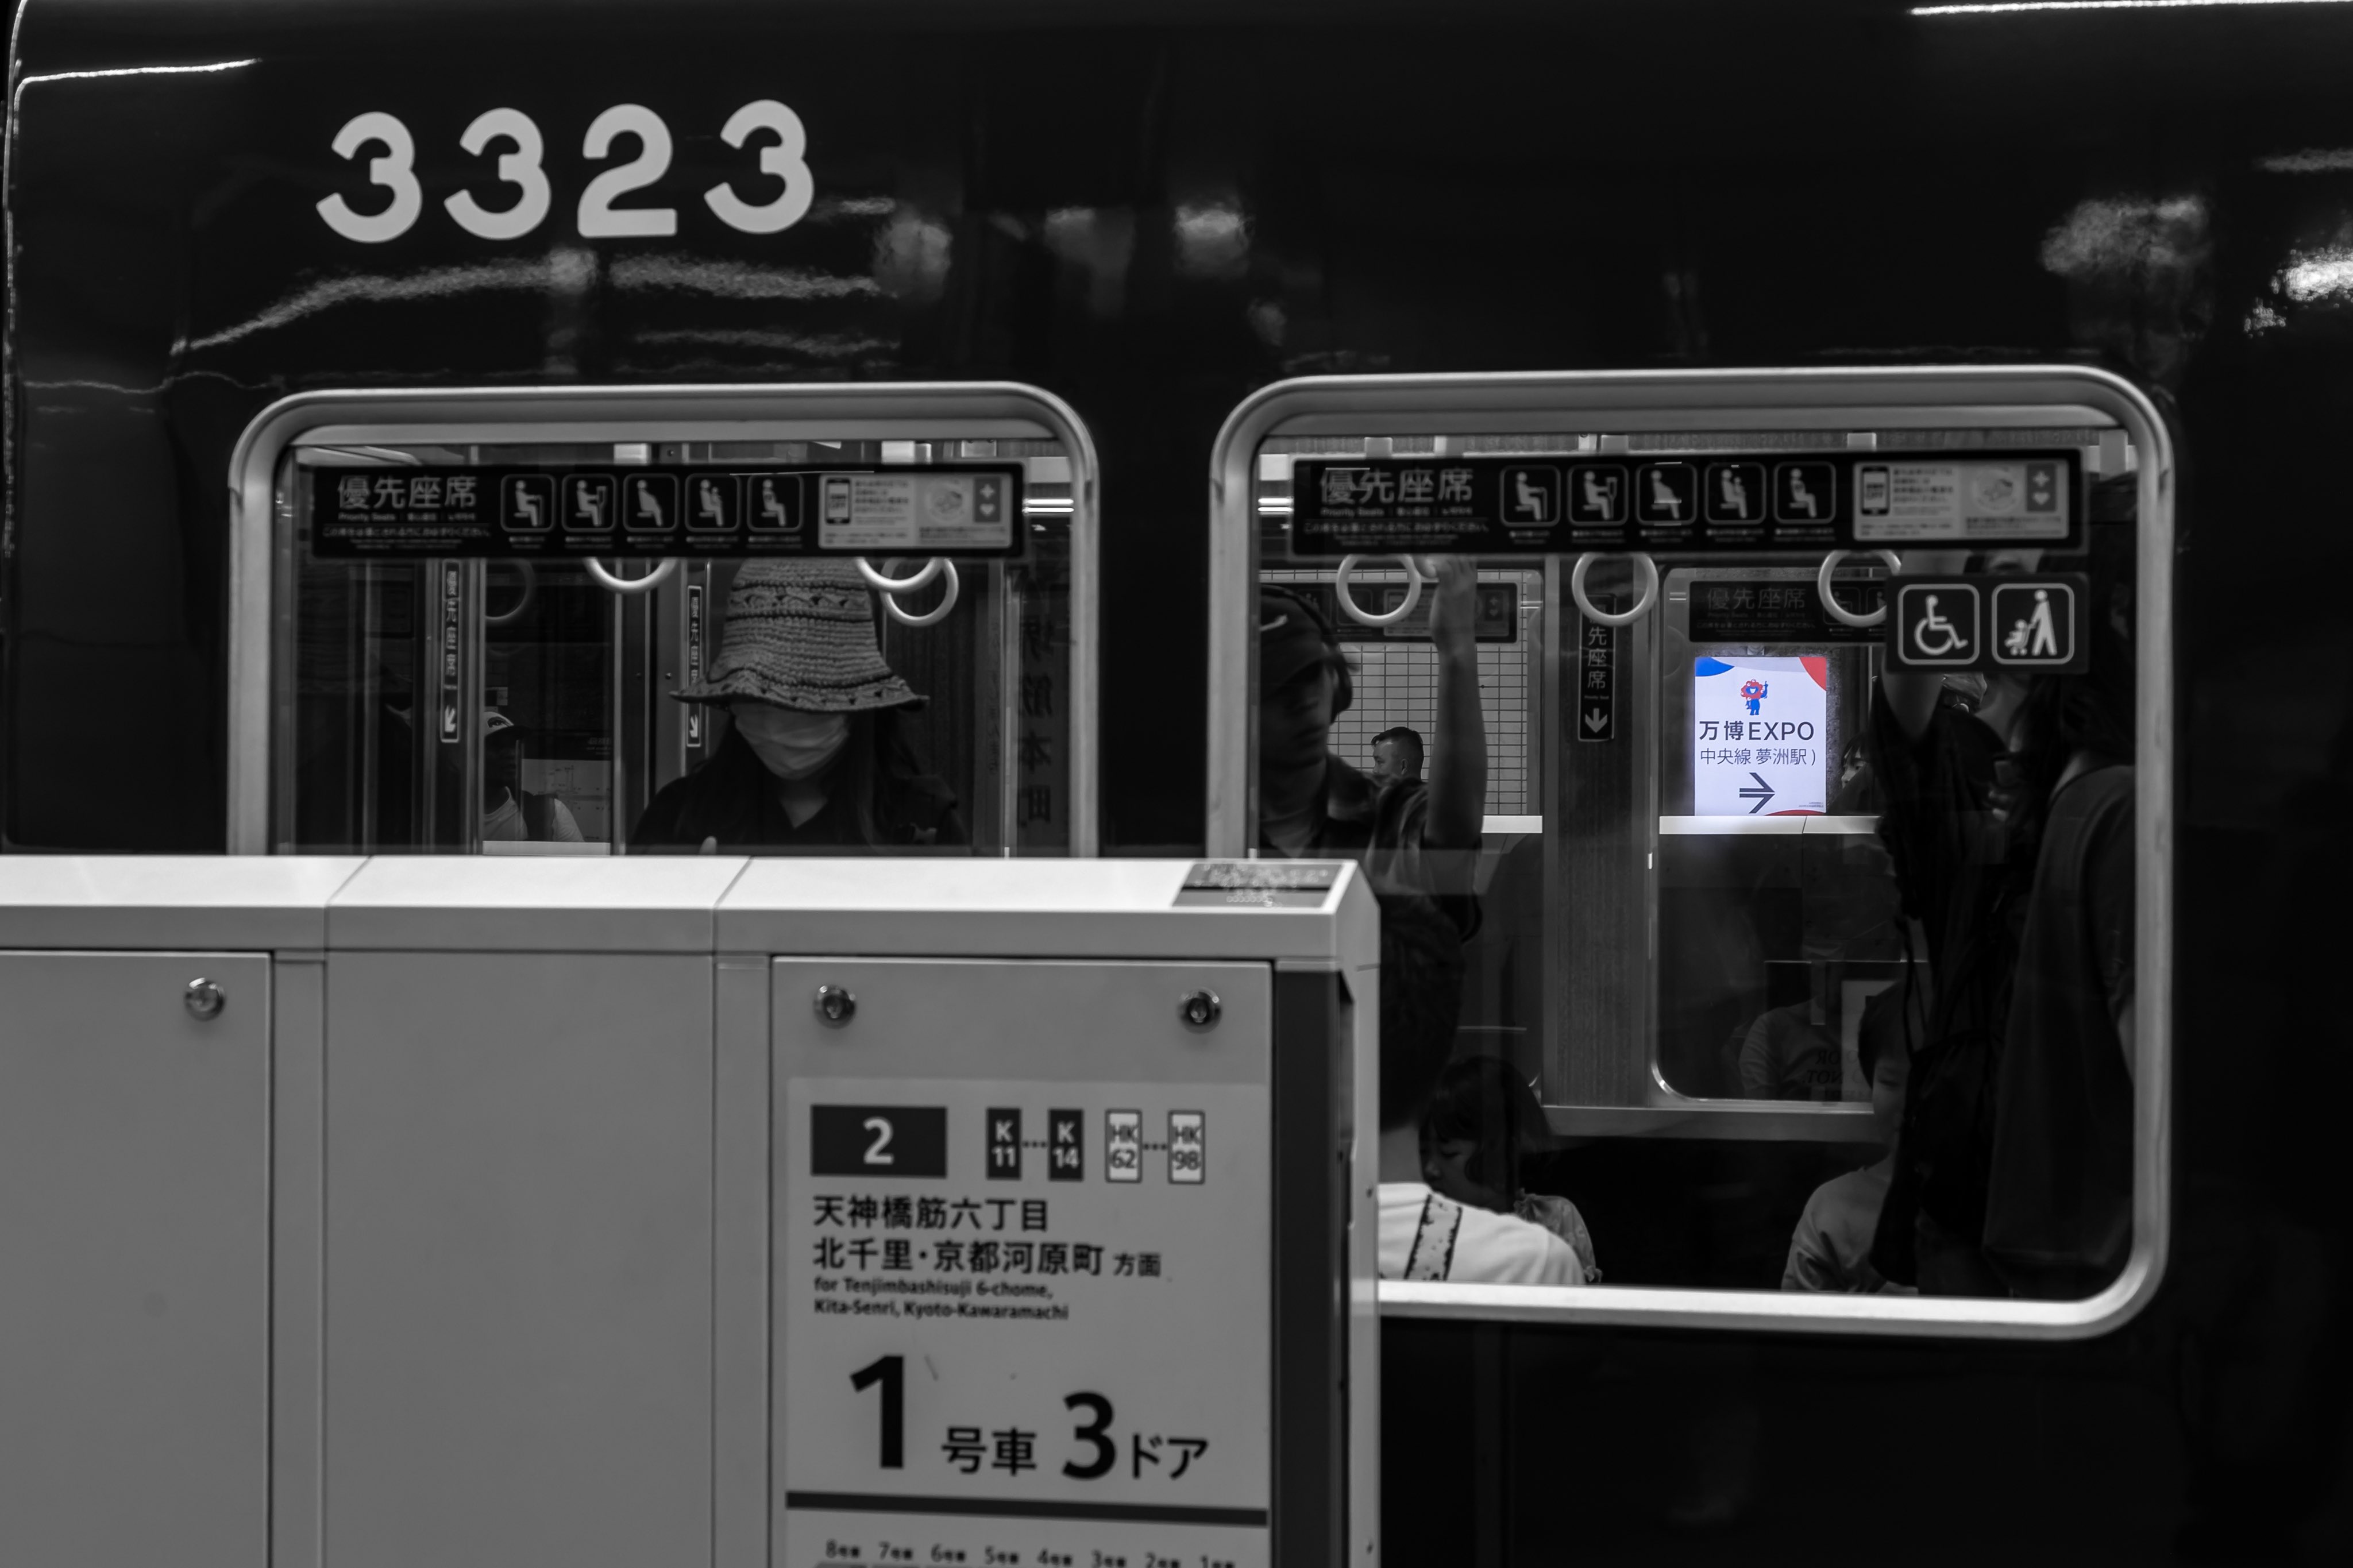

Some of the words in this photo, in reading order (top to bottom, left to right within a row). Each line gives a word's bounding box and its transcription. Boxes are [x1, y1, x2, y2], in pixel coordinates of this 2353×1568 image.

[315, 99, 814, 243] 3323
[337, 474, 477, 510] 優先座席
[1320, 468, 1474, 504] 優先座席
[1707, 586, 1806, 611] 優先座席
[1699, 720, 1814, 741] 万博EXPO
[1700, 748, 1752, 765] 中央線
[863, 1117, 894, 1164] 2
[995, 1119, 1013, 1143] K
[1057, 1121, 1075, 1144] K
[1110, 1124, 1137, 1144] HK
[1172, 1125, 1201, 1145] HK
[992, 1145, 1016, 1168] 11
[1053, 1146, 1079, 1168] 14
[1111, 1149, 1135, 1169] 62
[1174, 1150, 1201, 1170] 98
[813, 1195, 1048, 1232] 天神橋筋六丁目
[812, 1237, 1105, 1277] 北千里・京都河原町
[1113, 1252, 1162, 1277] 方面
[814, 1277, 838, 1292] for
[843, 1277, 972, 1298] Tenjimbashisuji
[976, 1280, 1053, 1299] 6-chome,
[813, 1299, 901, 1319] Kita-Senri,
[903, 1300, 1069, 1320] Kyoto-Kawaramachi
[849, 1354, 904, 1469] 1
[941, 1426, 1037, 1476] 号車
[1061, 1391, 1117, 1481] 3
[1132, 1432, 1209, 1480] ドア
